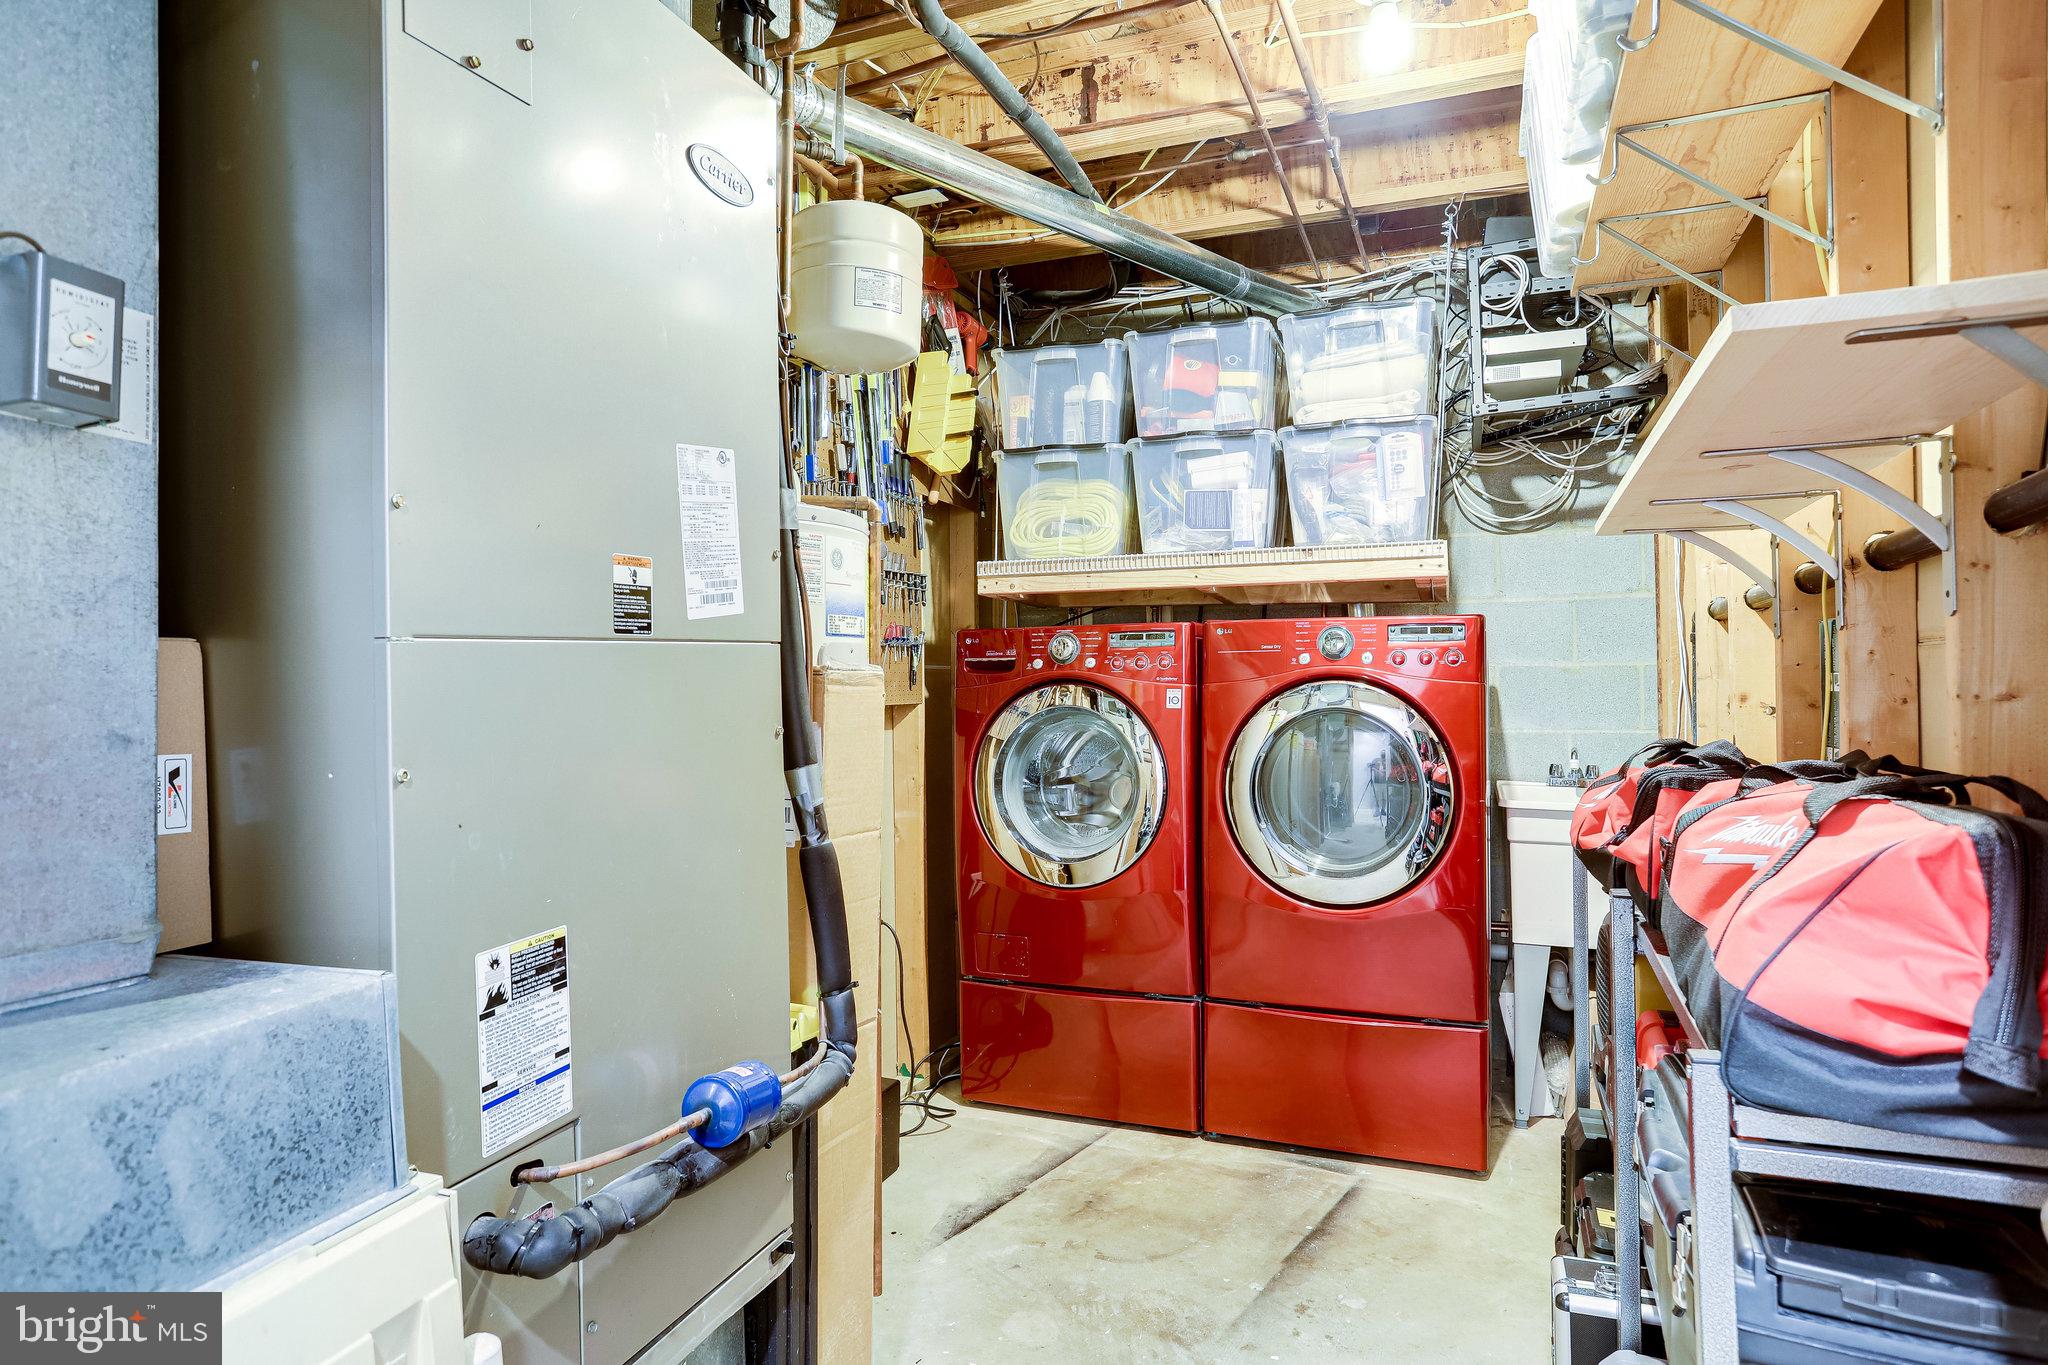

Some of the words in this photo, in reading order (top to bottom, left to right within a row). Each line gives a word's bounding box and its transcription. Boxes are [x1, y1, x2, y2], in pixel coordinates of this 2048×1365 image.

[700, 154, 747, 195] Carrier
[58, 375, 100, 392] Honeywell
[1703, 815, 1799, 849] Milwauke
[535, 933, 554, 944] CAUTION
[507, 993, 540, 1009] INSTALLATION
[517, 1064, 536, 1076] SERVICE
